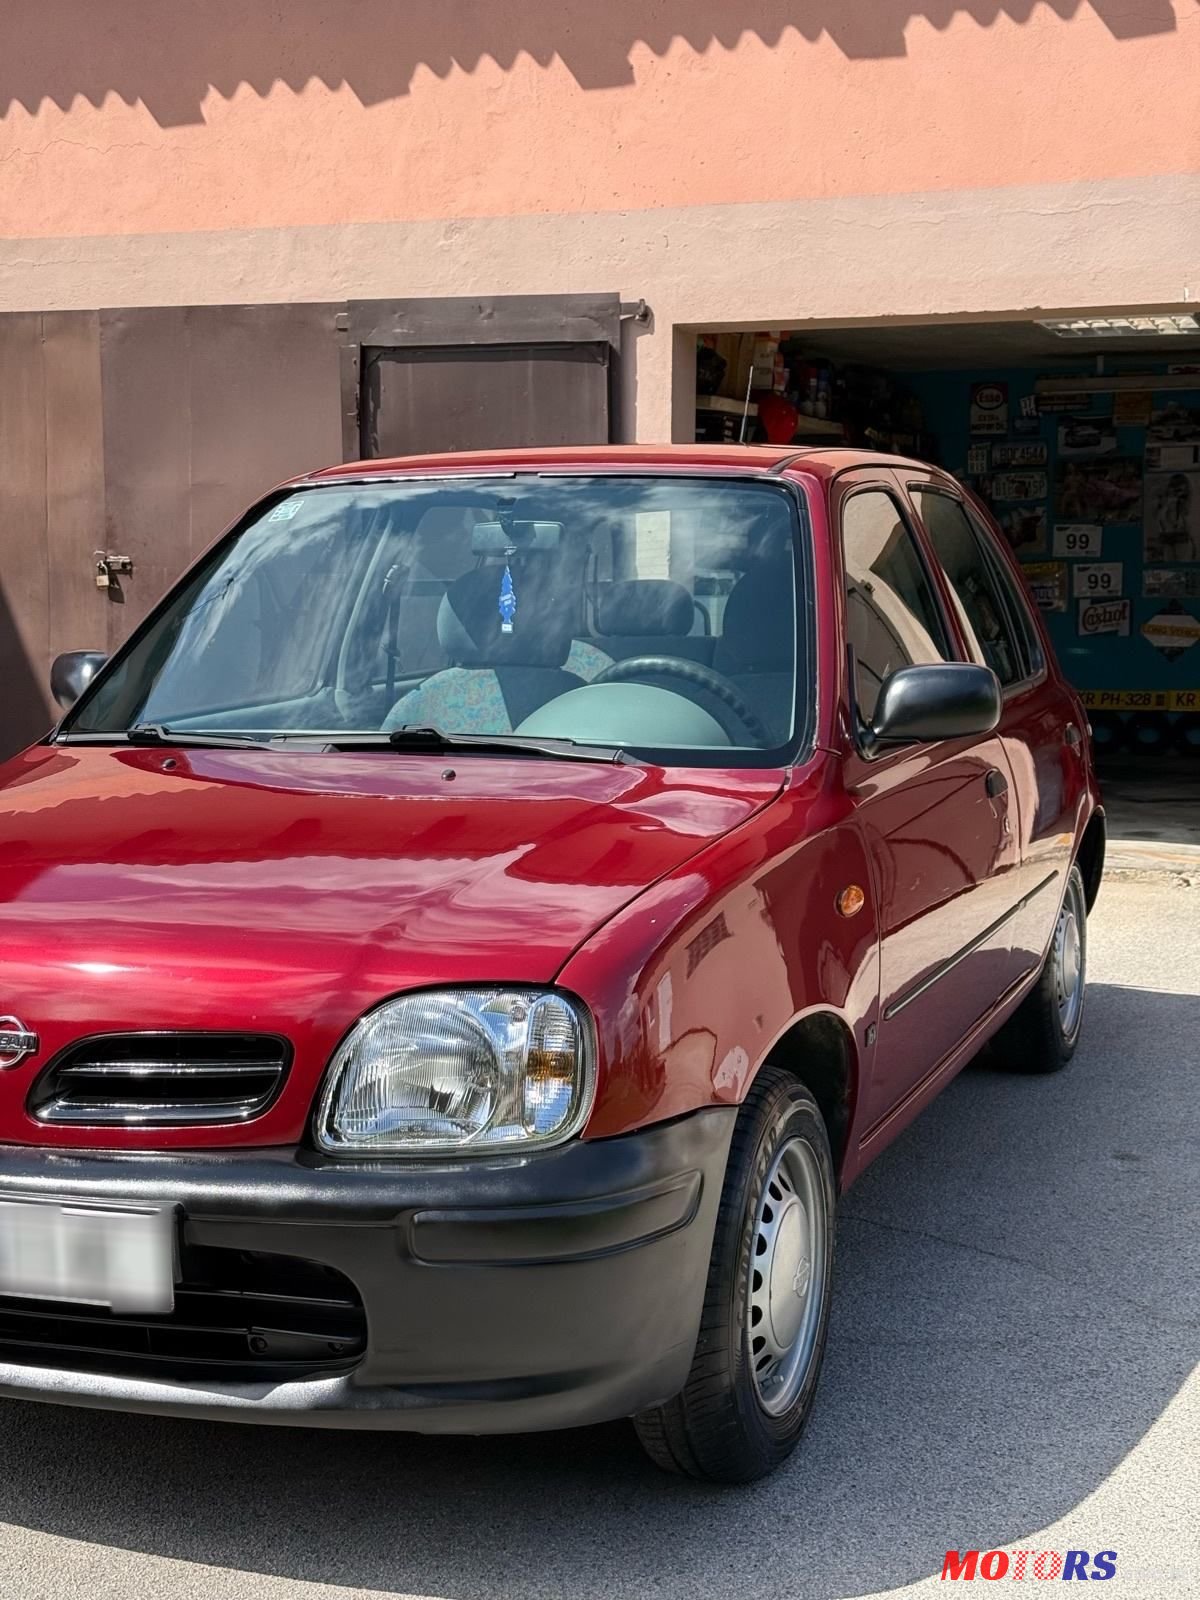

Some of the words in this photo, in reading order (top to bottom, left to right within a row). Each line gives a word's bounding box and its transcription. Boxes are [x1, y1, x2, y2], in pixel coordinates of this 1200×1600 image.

[1066, 533, 1089, 549] 99
[1087, 573, 1111, 589] 99
[1082, 602, 1128, 632] Castrol
[1100, 692, 1151, 706] PH-328
[1175, 692, 1196, 706] KR
